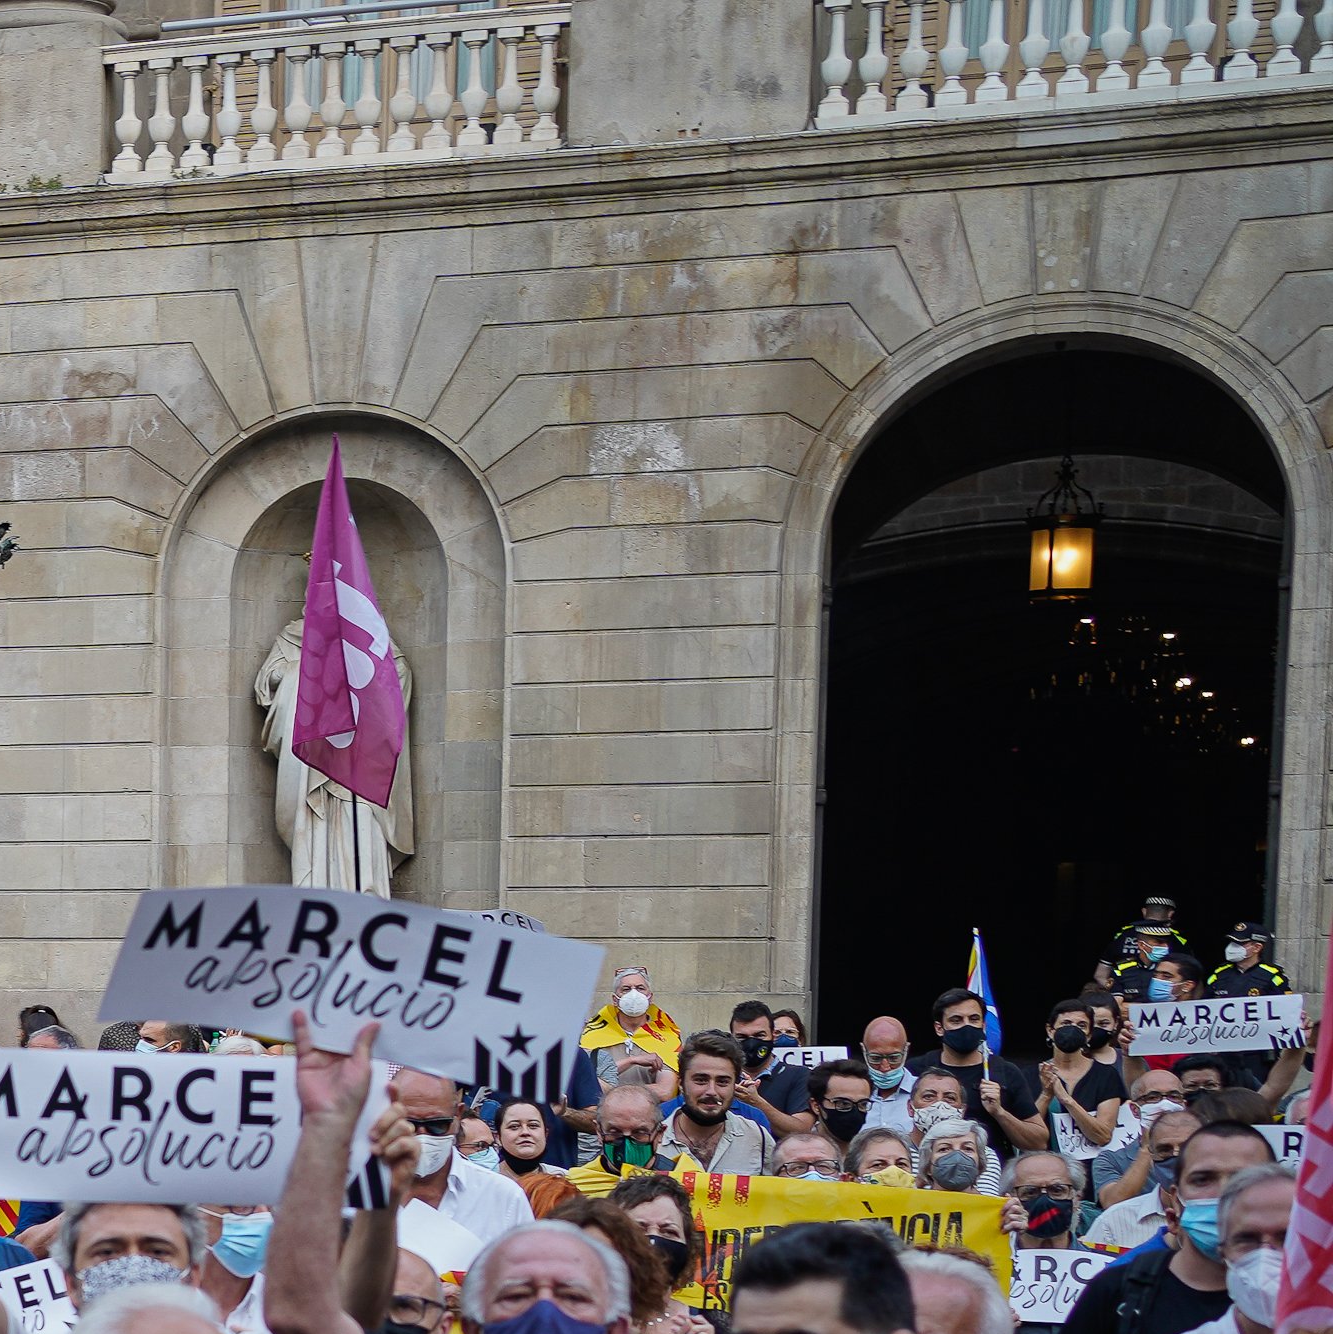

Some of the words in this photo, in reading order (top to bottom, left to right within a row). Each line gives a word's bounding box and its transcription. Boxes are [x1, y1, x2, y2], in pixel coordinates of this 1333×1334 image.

[142, 898, 526, 1003] MARCEL
[185, 938, 467, 1030] absolució
[1138, 1000, 1282, 1029] MARCEL
[1159, 1015, 1261, 1046] absolució
[17, 1101, 281, 1186] absolució
